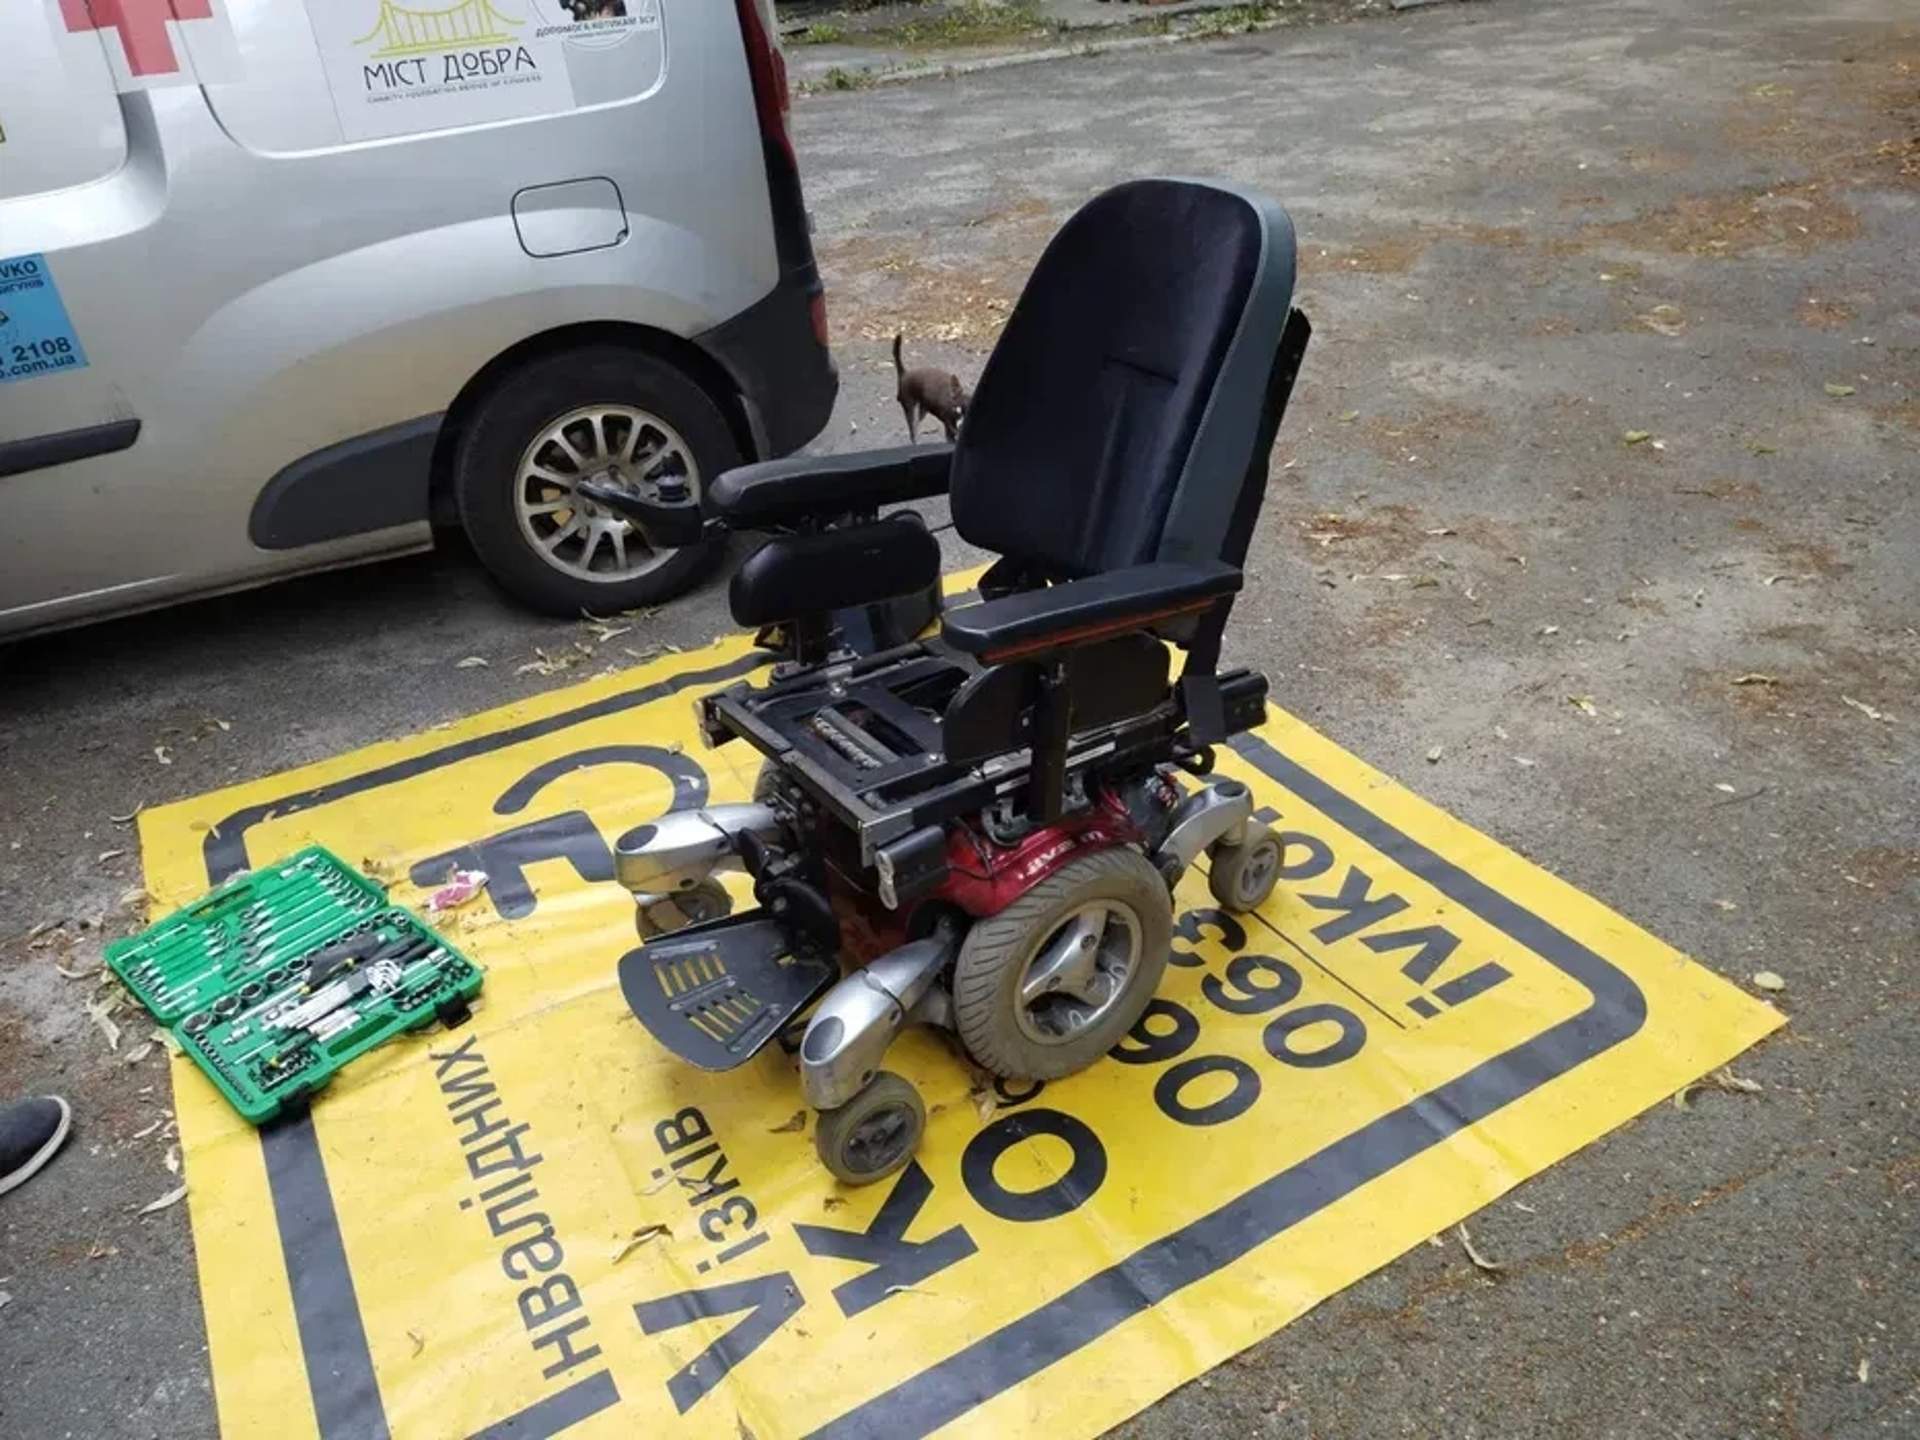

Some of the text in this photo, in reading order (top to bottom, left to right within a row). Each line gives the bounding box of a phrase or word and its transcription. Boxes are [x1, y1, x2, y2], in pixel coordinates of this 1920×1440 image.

[363, 46, 537, 91] МІСТ ДОБРА
[0, 260, 38, 278] VKO
[11, 336, 72, 363] 2108
[1107, 998, 1261, 1126] 06
